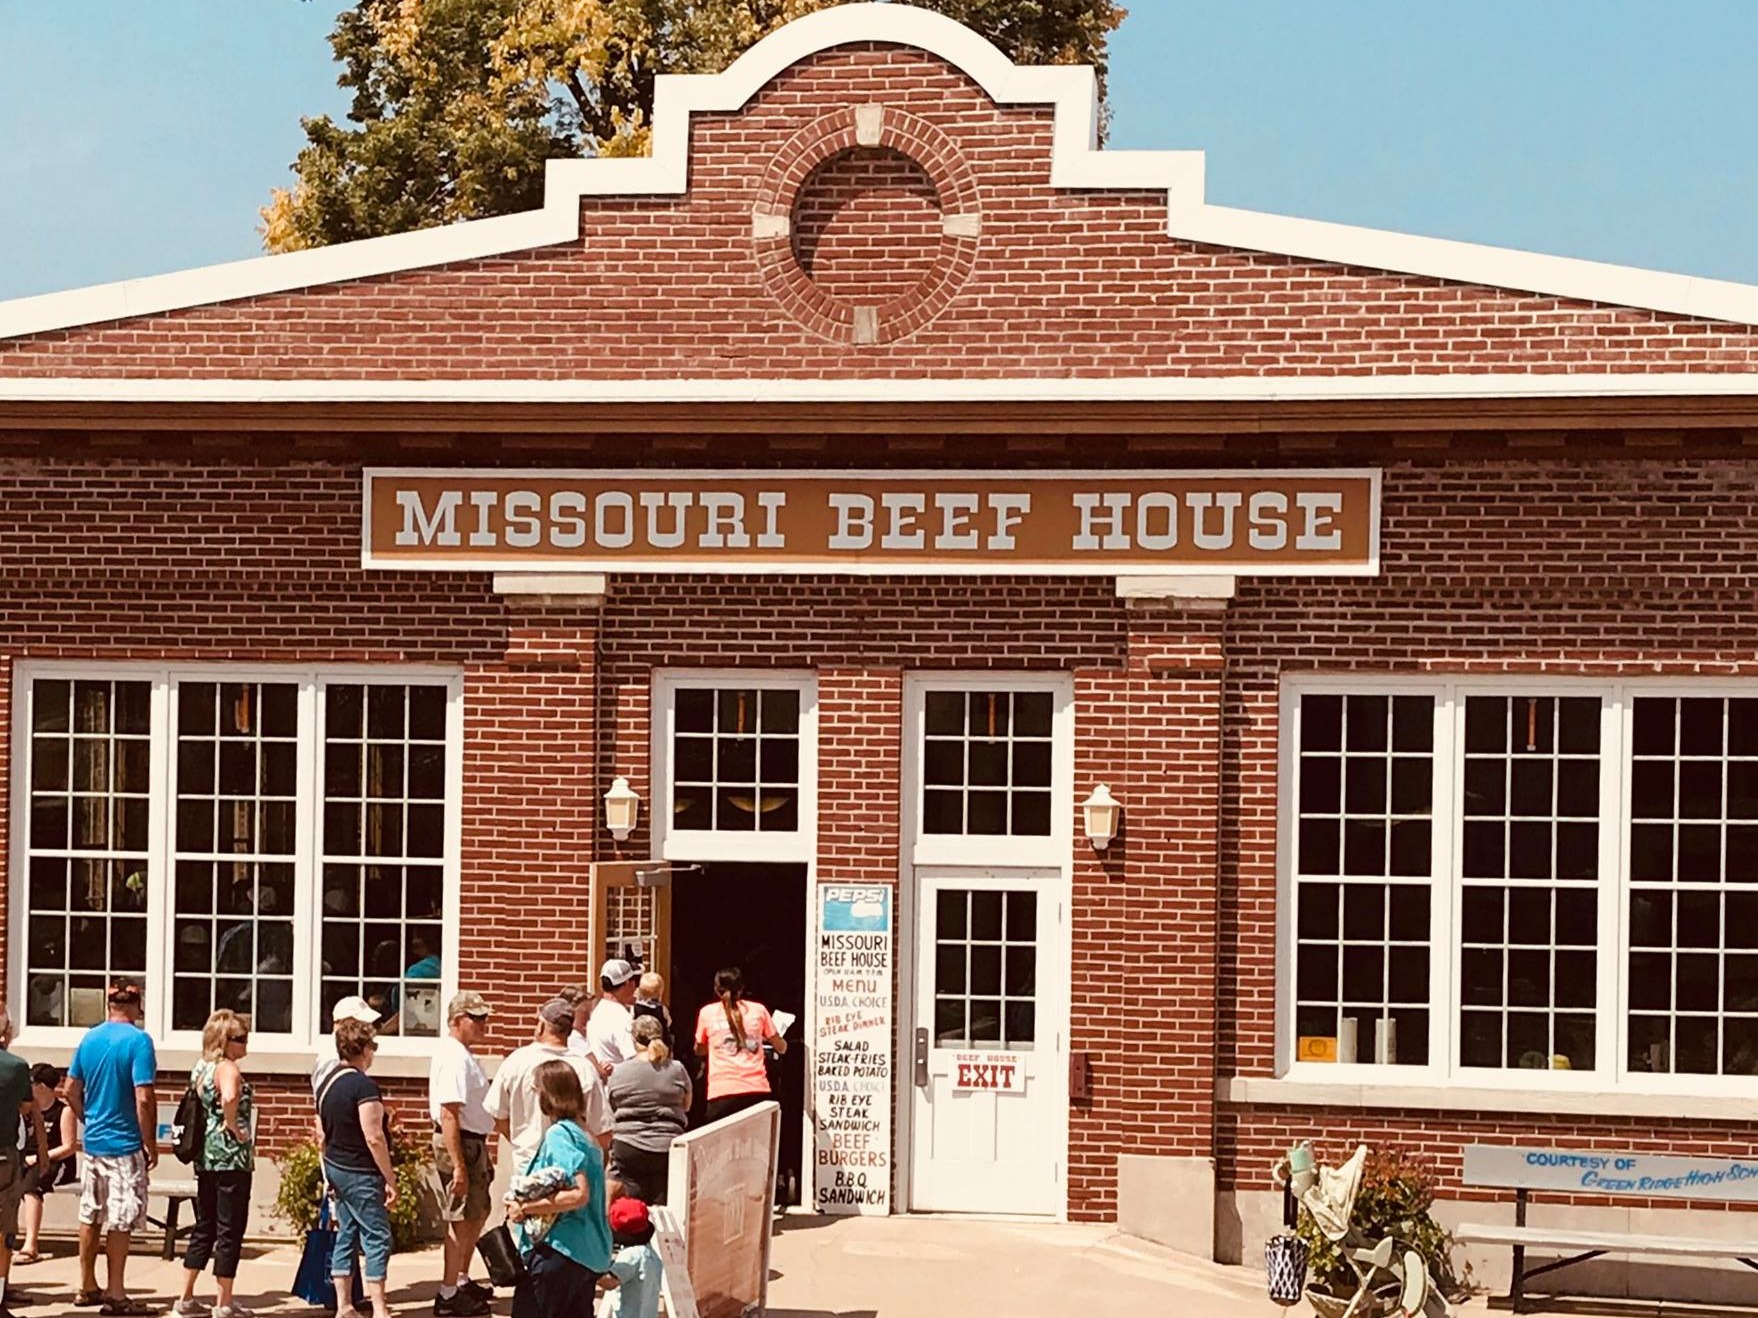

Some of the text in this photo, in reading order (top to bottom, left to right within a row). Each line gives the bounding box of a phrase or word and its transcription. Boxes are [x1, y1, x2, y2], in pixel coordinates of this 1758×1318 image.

[395, 490, 1343, 551] MISSOURI BEEF HOUSE
[826, 888, 885, 902] PEPSI
[821, 935, 887, 950] MISSOURI
[821, 951, 887, 967] BEEF HOUSE
[852, 996, 887, 1008] CHOICE
[834, 1040, 869, 1052] SALAD
[818, 1065, 888, 1078] BAKED POTATO
[957, 1063, 1016, 1089] EXIT
[829, 1094, 873, 1106] RIB EYE
[829, 1107, 869, 1118] STEAK
[819, 1119, 880, 1131] SANDWICH
[833, 1133, 871, 1149] BEEF
[818, 1150, 887, 1167] BURGERS
[1525, 1152, 1637, 1171] COURTESY OF
[819, 1187, 885, 1205] SANDWICH
